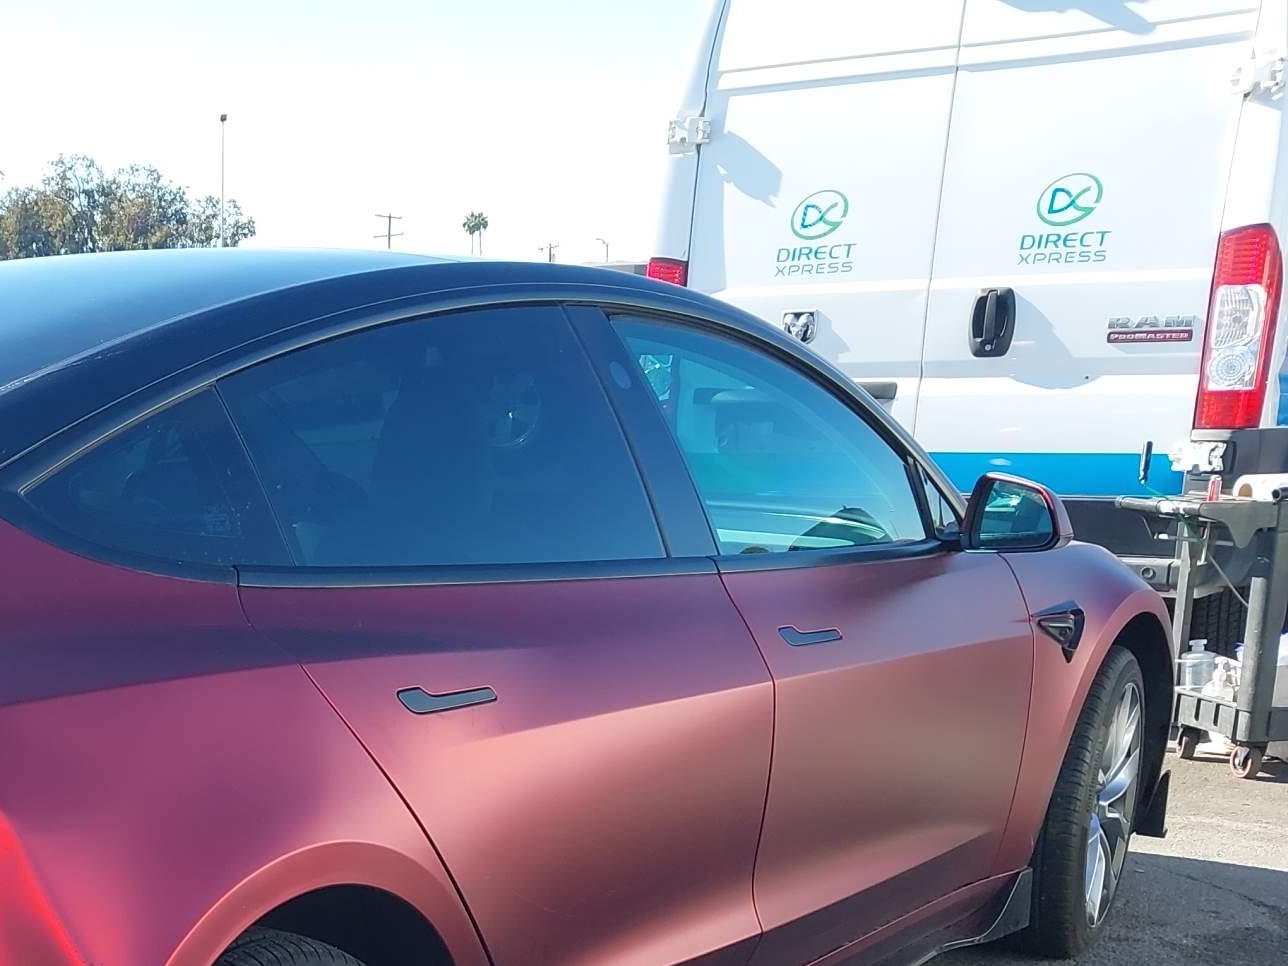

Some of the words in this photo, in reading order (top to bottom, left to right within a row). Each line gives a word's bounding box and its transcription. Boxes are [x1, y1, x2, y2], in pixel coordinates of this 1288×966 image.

[1019, 230, 1113, 250] DIRECT
[775, 243, 857, 263] DIRECT
[1017, 249, 1108, 265] XPRESS
[774, 261, 854, 277] XPRESS
[1107, 314, 1194, 329] RAM
